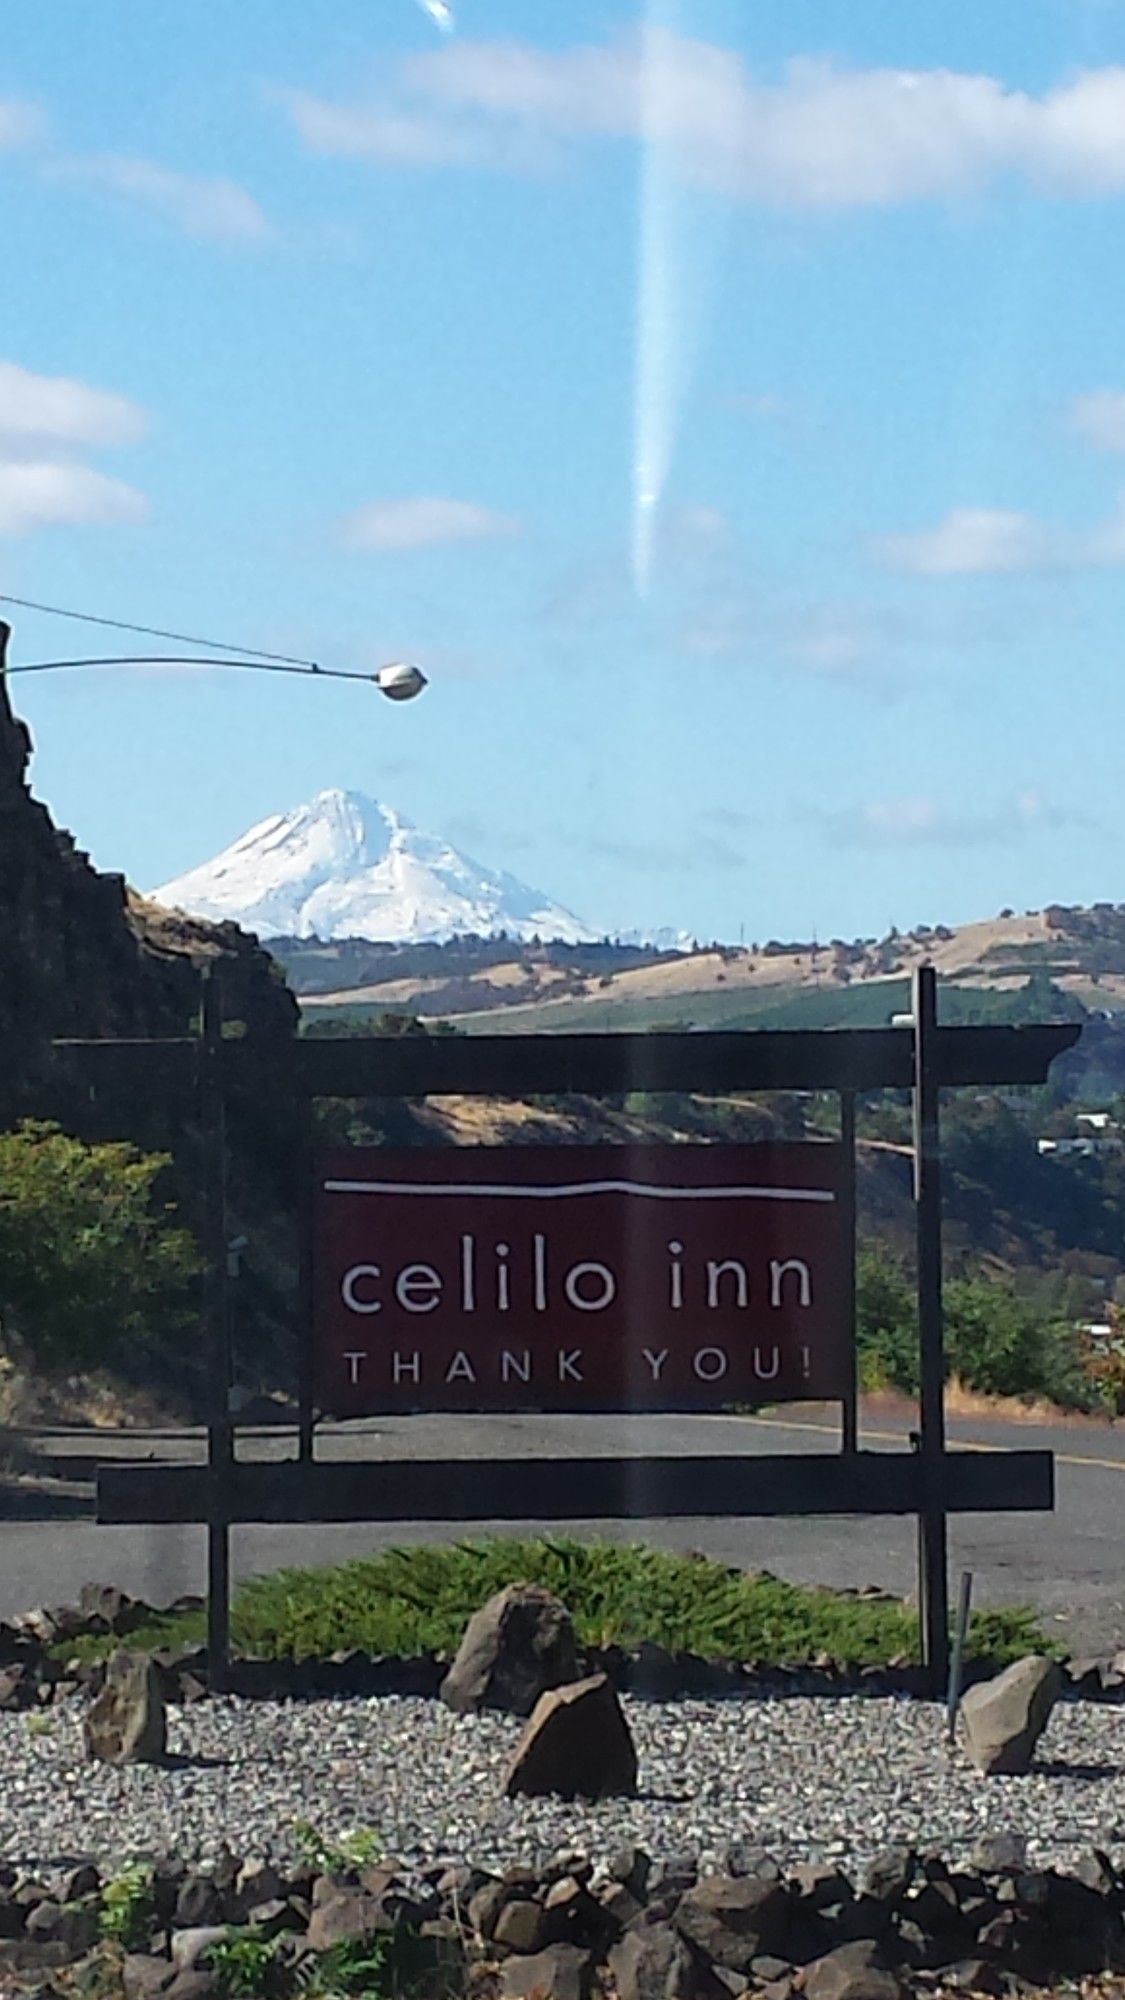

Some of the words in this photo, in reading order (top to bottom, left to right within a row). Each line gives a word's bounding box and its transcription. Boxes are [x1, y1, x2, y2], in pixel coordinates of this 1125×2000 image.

[341, 1234, 616, 1313] celilo
[668, 1241, 812, 1309] inn
[343, 1349, 584, 1383] THANK
[643, 1346, 813, 1380] YOU!
